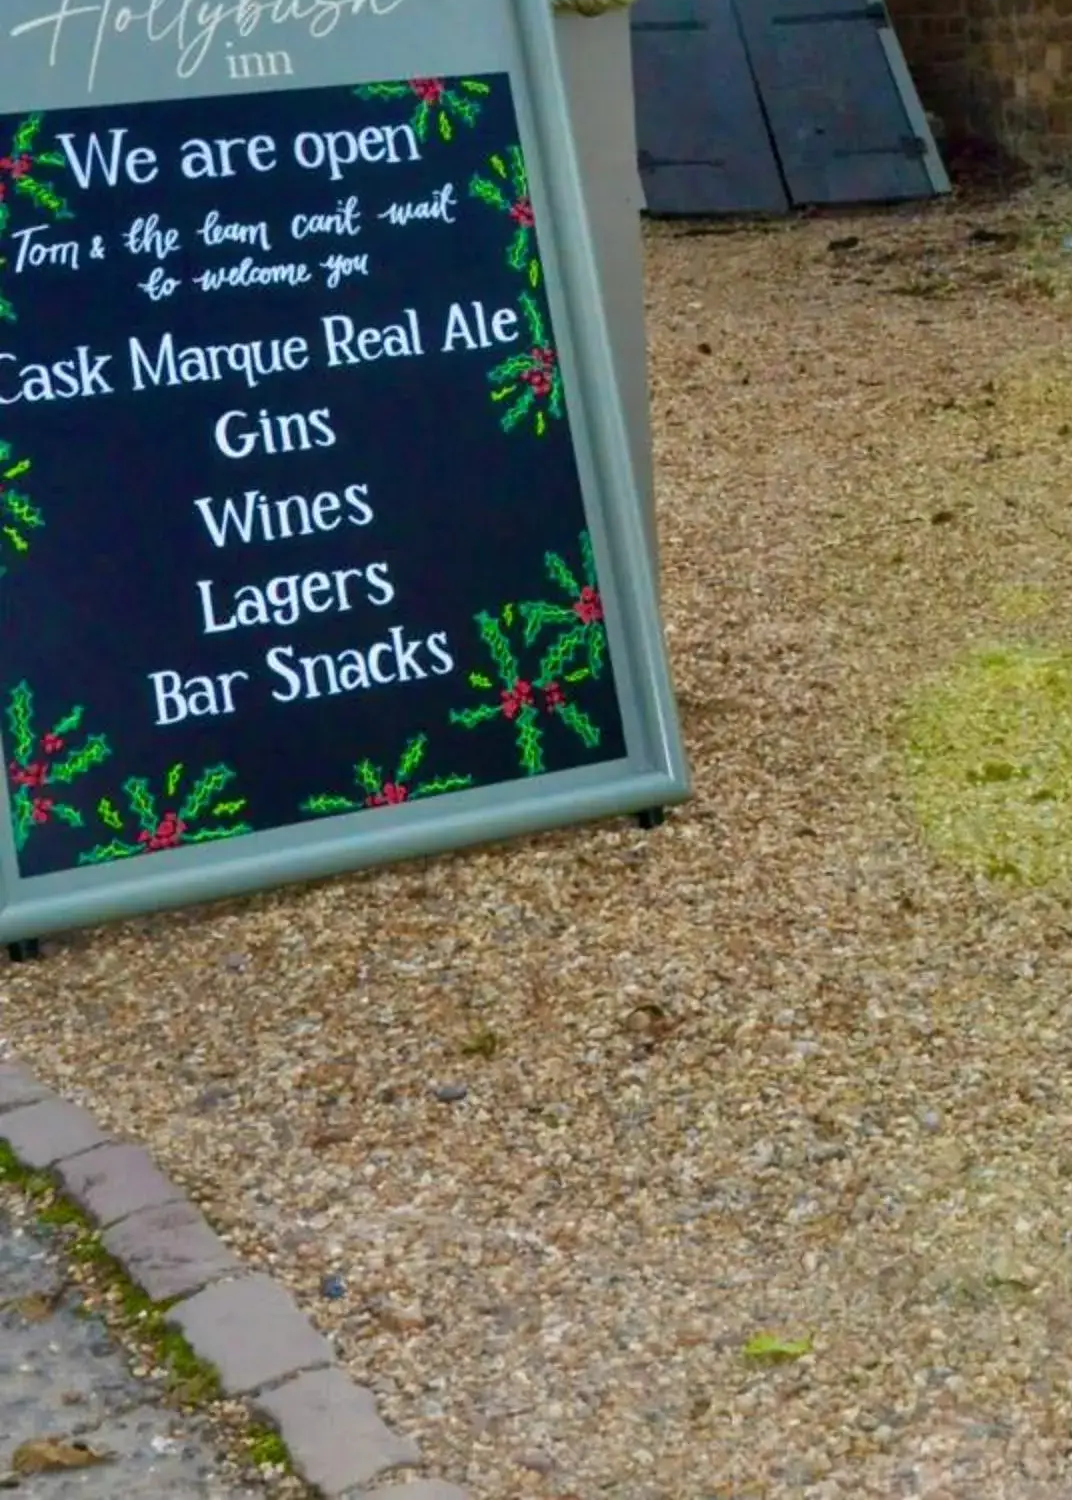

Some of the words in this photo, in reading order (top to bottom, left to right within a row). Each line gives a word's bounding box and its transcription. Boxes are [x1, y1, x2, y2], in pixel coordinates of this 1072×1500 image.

[224, 41, 294, 79] inn
[57, 127, 158, 189] We
[180, 134, 277, 180] are
[294, 121, 421, 180] open
[11, 224, 80, 273] Tom
[88, 232, 106, 260] &
[121, 212, 182, 260] the
[196, 209, 272, 252] team
[290, 195, 362, 240] can't
[377, 183, 457, 226] wait
[137, 266, 182, 302] to
[192, 256, 312, 292] welcome
[320, 250, 370, 288] you
[128, 330, 310, 391] Marque
[321, 306, 424, 368] Real
[441, 298, 520, 354] Ale
[214, 407, 336, 458] Gins
[195, 483, 374, 548] Wines
[197, 562, 395, 633] Lagers
[149, 668, 249, 725] Bar
[266, 625, 454, 703] Snacks
